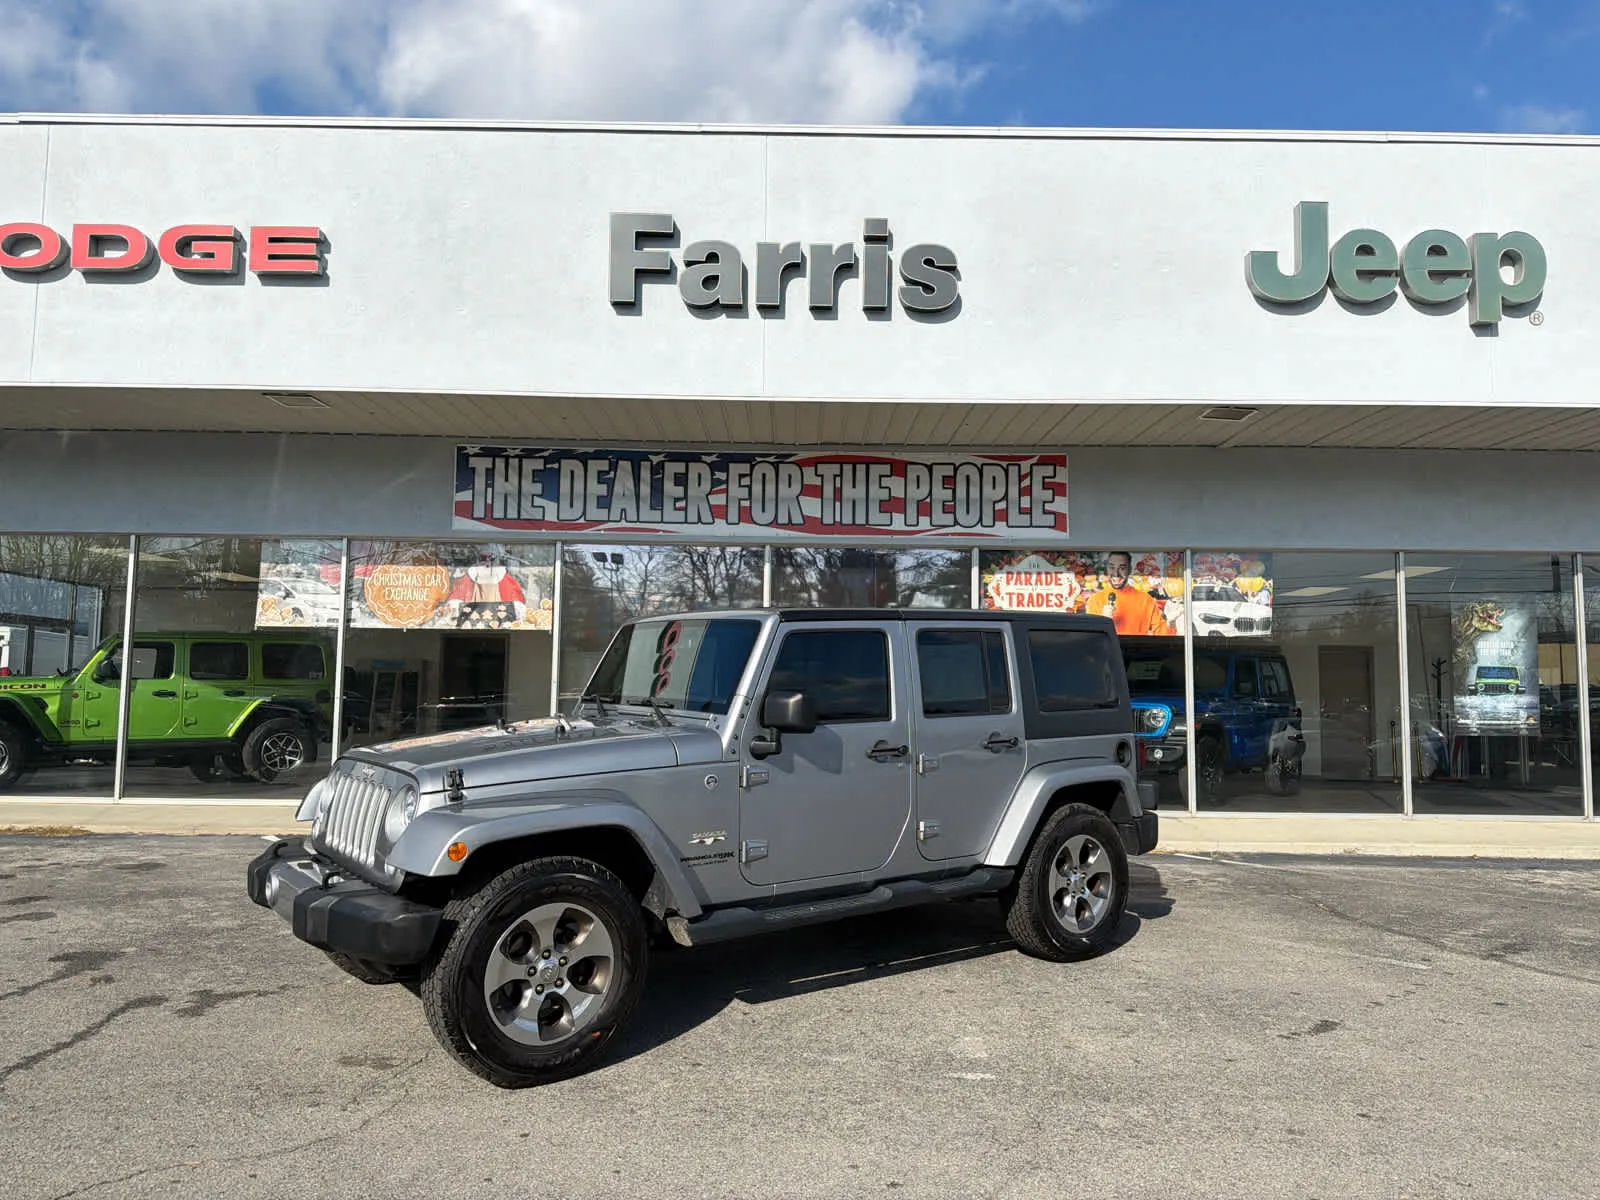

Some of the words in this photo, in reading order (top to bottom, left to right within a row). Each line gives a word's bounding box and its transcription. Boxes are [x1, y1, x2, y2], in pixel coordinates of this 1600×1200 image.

[609, 211, 960, 313] Farris
[1244, 200, 1548, 328] Jeep
[467, 455, 546, 521] THE
[556, 457, 715, 525] DEALER
[727, 460, 805, 526] FOR
[815, 461, 893, 527] THE
[904, 462, 1056, 528] PEOPLE
[373, 573, 423, 587] CHRISTMAS
[424, 573, 442, 587] CAR
[1005, 571, 1063, 586] PARADE
[384, 587, 430, 601] EXCHANGE
[1005, 592, 1064, 608] TRADES
